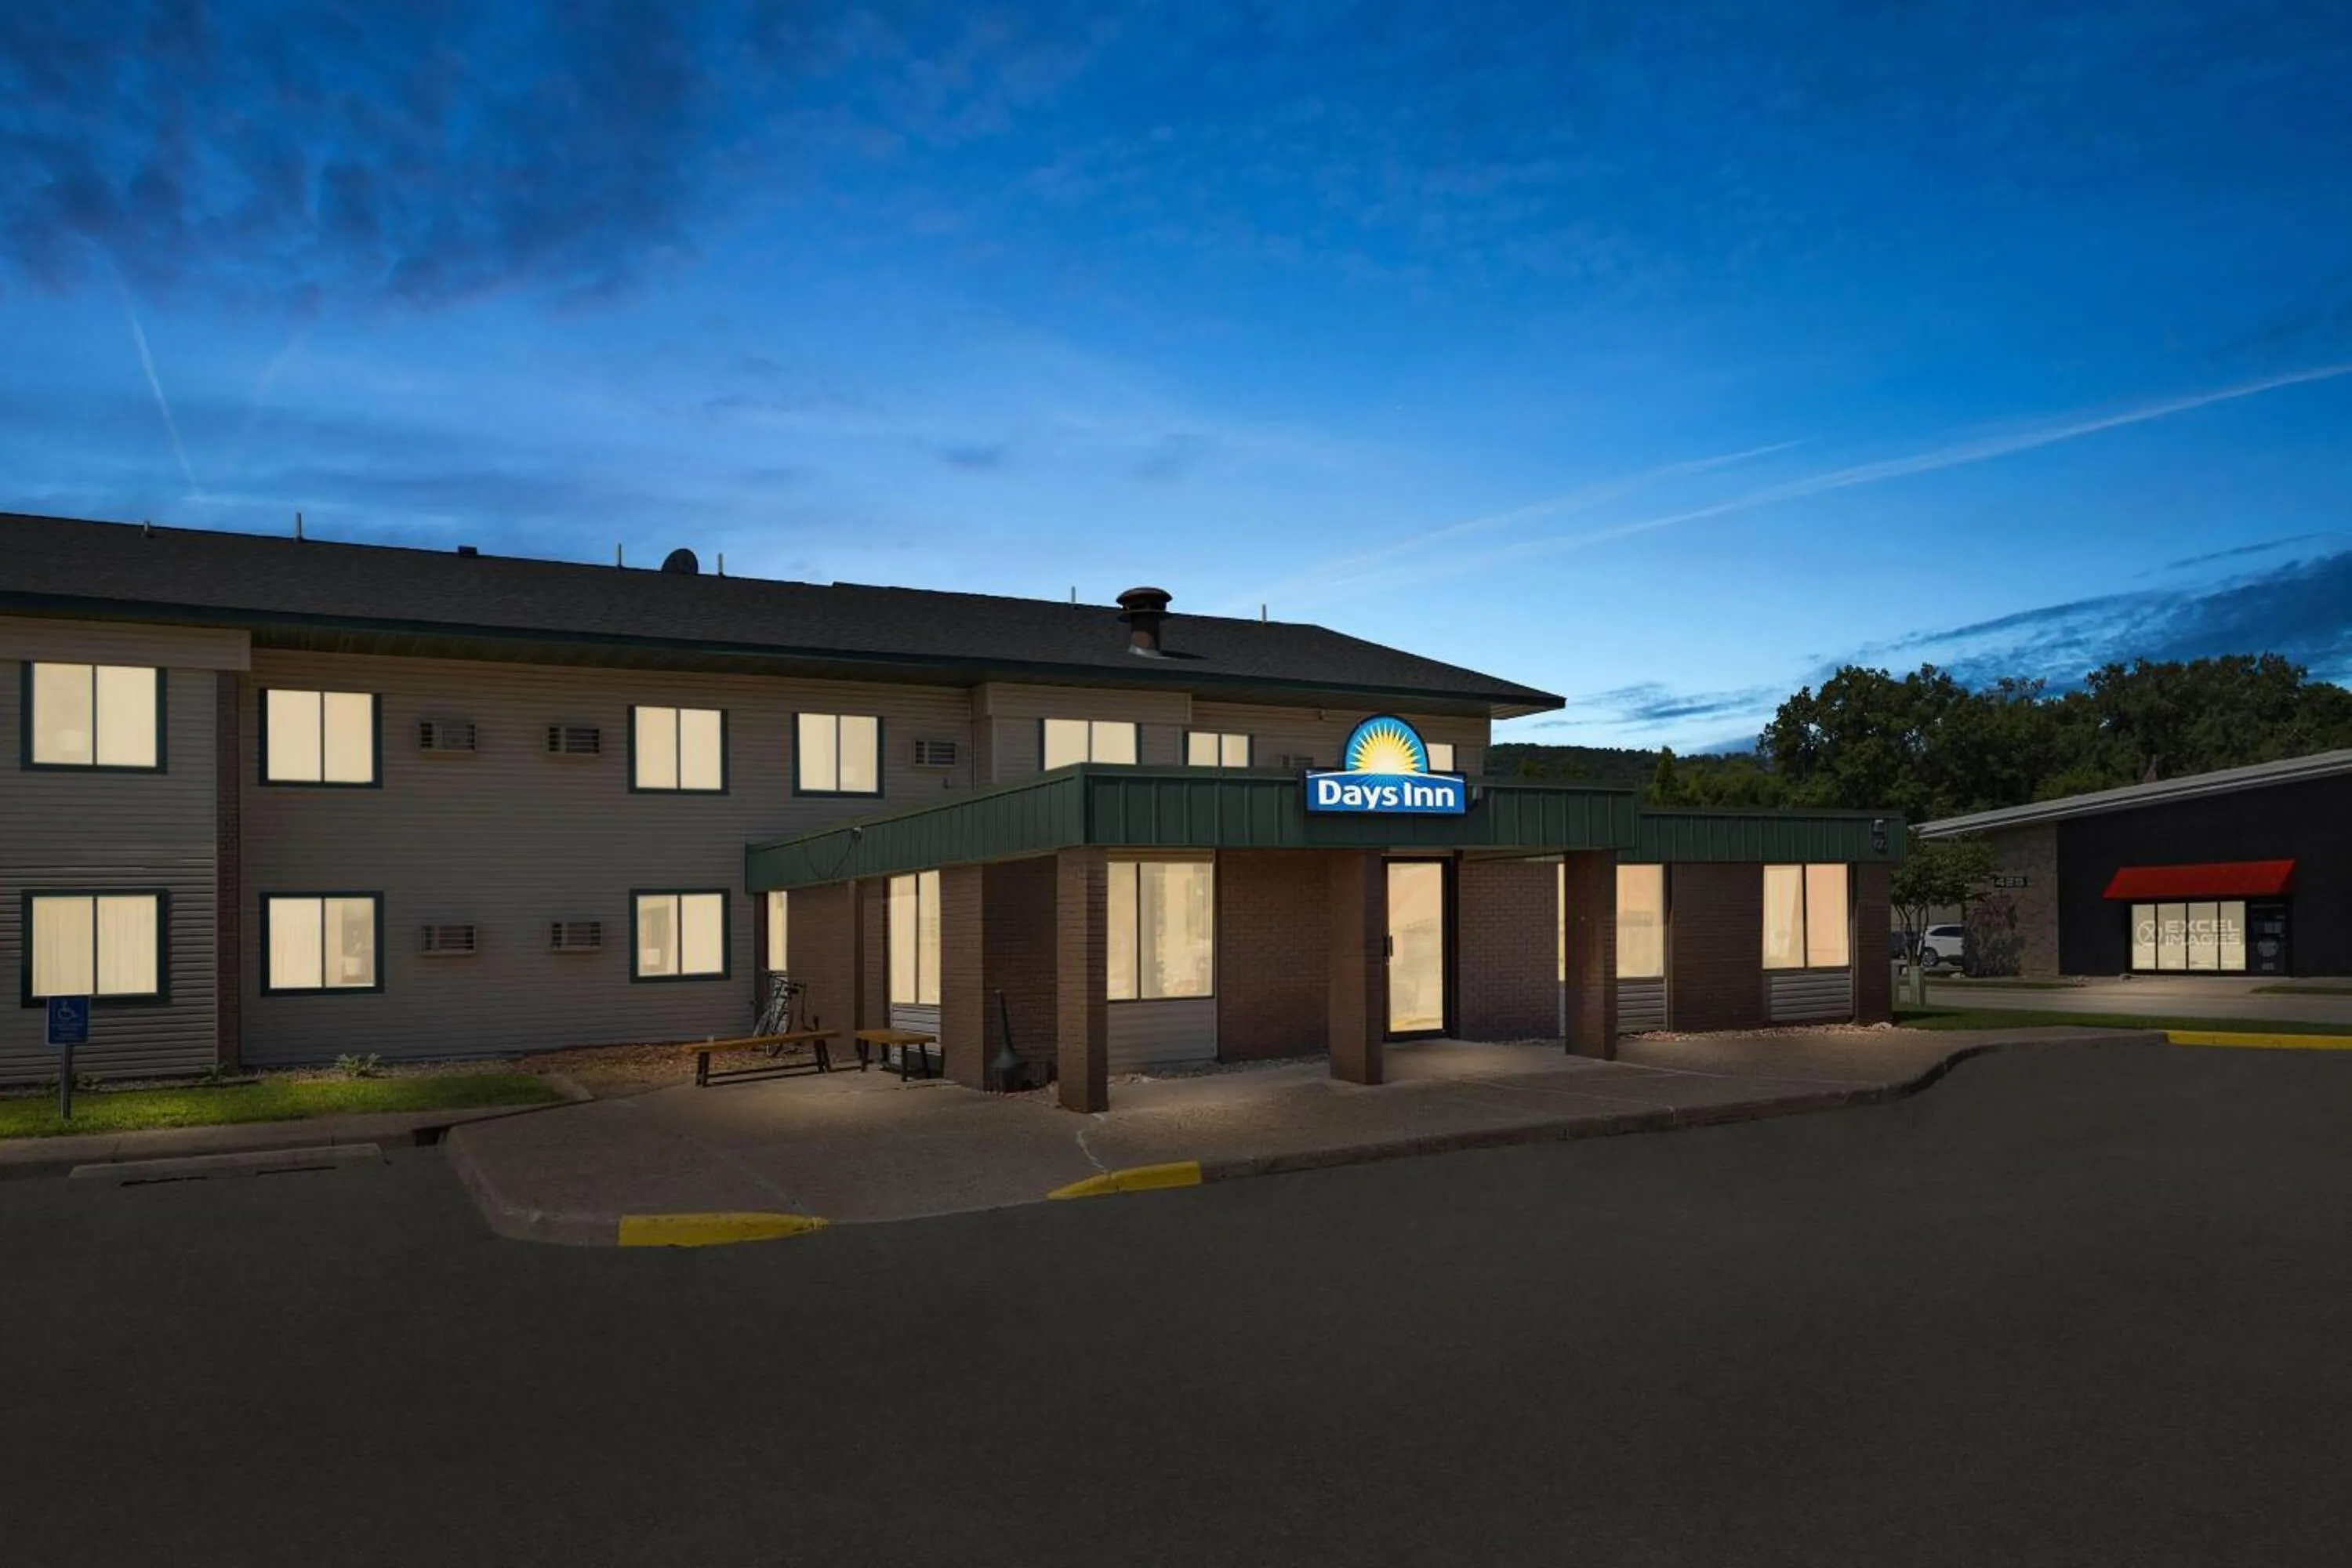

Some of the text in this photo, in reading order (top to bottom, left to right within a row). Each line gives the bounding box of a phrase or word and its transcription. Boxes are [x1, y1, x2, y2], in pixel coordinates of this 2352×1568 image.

[1317, 779, 1455, 810] Days Inn
[2165, 920, 2241, 933] EXCEL
[2165, 934, 2241, 946] IMAGES
